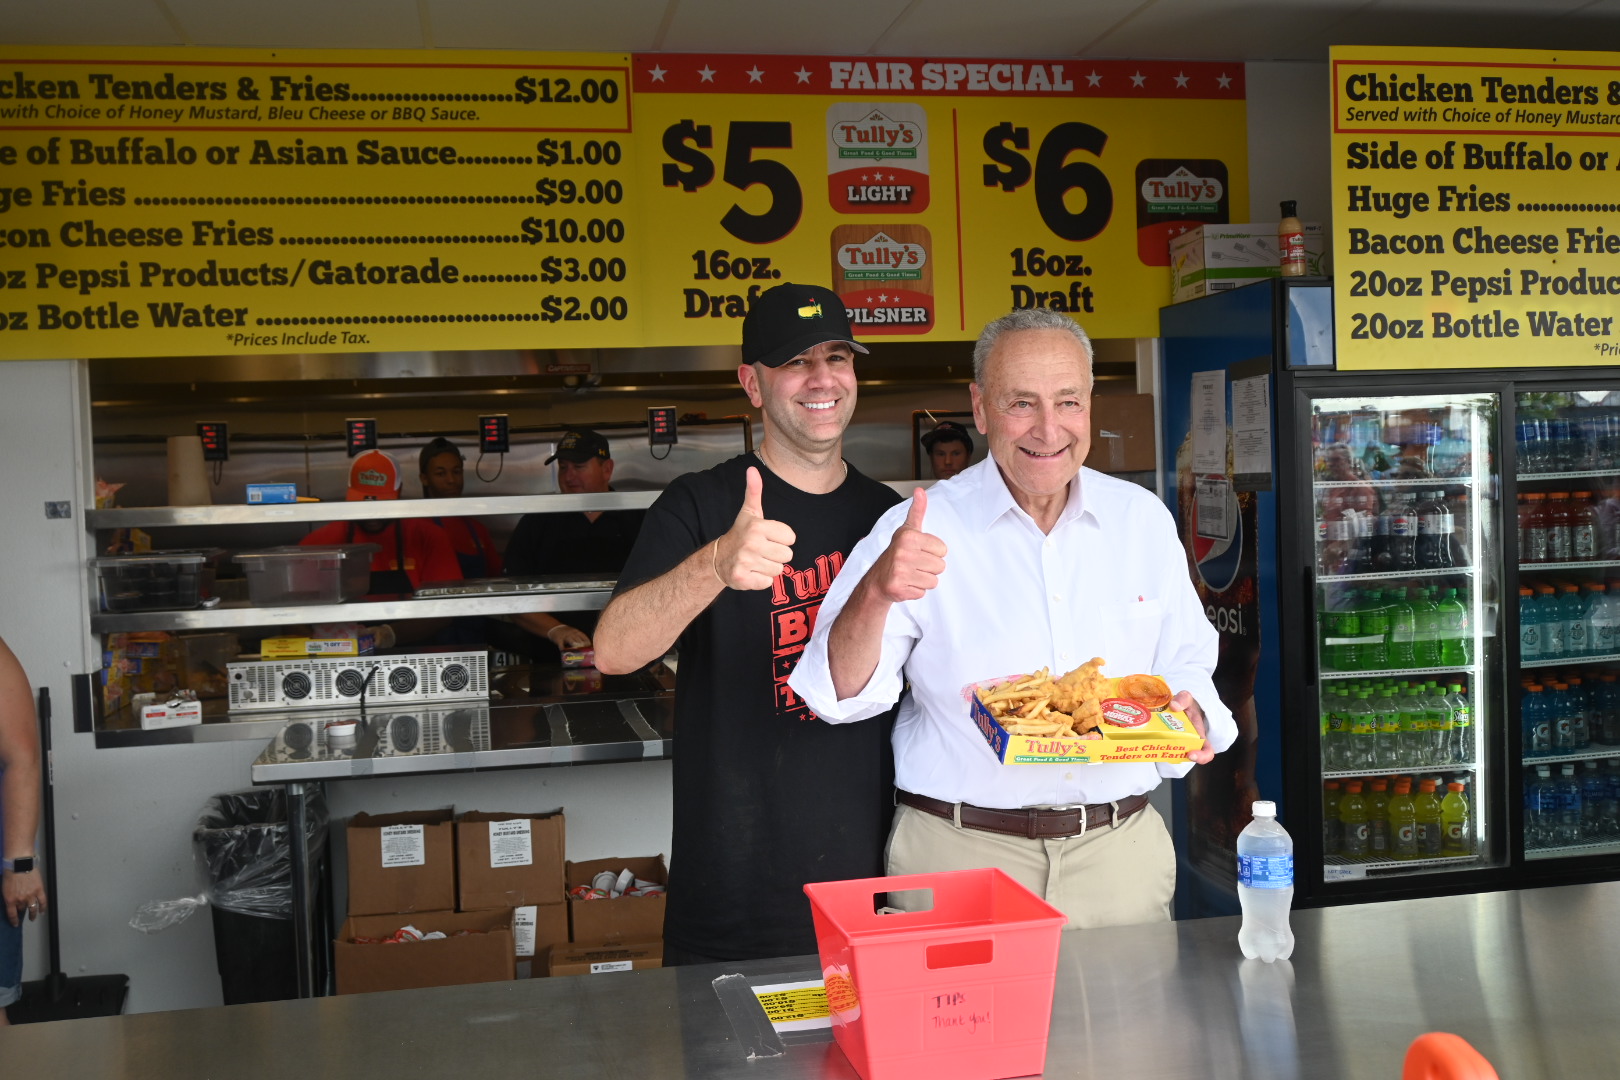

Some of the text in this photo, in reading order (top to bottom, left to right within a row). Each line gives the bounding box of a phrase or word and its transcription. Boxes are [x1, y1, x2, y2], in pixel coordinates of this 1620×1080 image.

[88, 74, 226, 101] Tenders
[237, 77, 261, 101] &
[270, 76, 350, 102] Fries
[514, 76, 619, 104] $12.00
[830, 61, 1074, 92] FAIR SPECIAL
[1346, 74, 1474, 103] Chicken
[1481, 76, 1598, 106] Tenders
[1, 104, 480, 124] with Choice of Honey Mustard, Bleu Cheese or BBQ Sauce.
[1346, 106, 1400, 122] Served
[1403, 107, 1438, 122] with
[1442, 107, 1492, 124] Choice
[1495, 107, 1512, 124] of
[1515, 109, 1562, 127] Honey
[840, 124, 914, 147] Tully's
[26, 137, 61, 165] of
[70, 137, 198, 165] Buffalo
[206, 143, 240, 165] or
[250, 140, 348, 166] Asian
[356, 140, 458, 166] Sauce
[536, 138, 622, 166] $1.00
[1346, 141, 1418, 170] Side
[1426, 141, 1457, 171] of
[1463, 142, 1573, 172] Buffalo
[1579, 152, 1609, 171] or
[42, 178, 126, 206] Fries
[535, 177, 623, 206] $9.00
[662, 119, 803, 244] $5
[847, 186, 911, 202] LIGHT
[982, 121, 1114, 242] $6
[1148, 179, 1216, 202] Tully's
[1348, 184, 1511, 218] Huge Fries
[60, 220, 183, 247] Cheese
[192, 220, 274, 247] Fries
[520, 217, 625, 245] $10.00
[1348, 228, 1444, 255] Bacon
[1452, 226, 1559, 254] Cheese
[692, 249, 782, 280] 16oz.
[845, 245, 918, 268] Tully's
[1010, 248, 1093, 278] 16oz.
[36, 260, 130, 295] Pepsi
[139, 258, 459, 288] Products/Gatorade
[540, 256, 626, 284] $3.00
[1350, 270, 1422, 298] 20oz
[1431, 269, 1512, 302] Pepsi
[38, 302, 140, 330] Bottle
[147, 302, 248, 328] Water
[540, 294, 628, 324] $2.00
[683, 284, 762, 318] Draf
[1010, 283, 1094, 313] Draft
[846, 307, 926, 323] PILSNER
[1351, 310, 1613, 340] 20oz Bottle Water
[281, 332, 336, 346] Include
[340, 331, 370, 345] Tax.
[1206, 602, 1242, 634] epsi
[1025, 740, 1087, 756] Tully's
[932, 1015, 965, 1029] Thank
